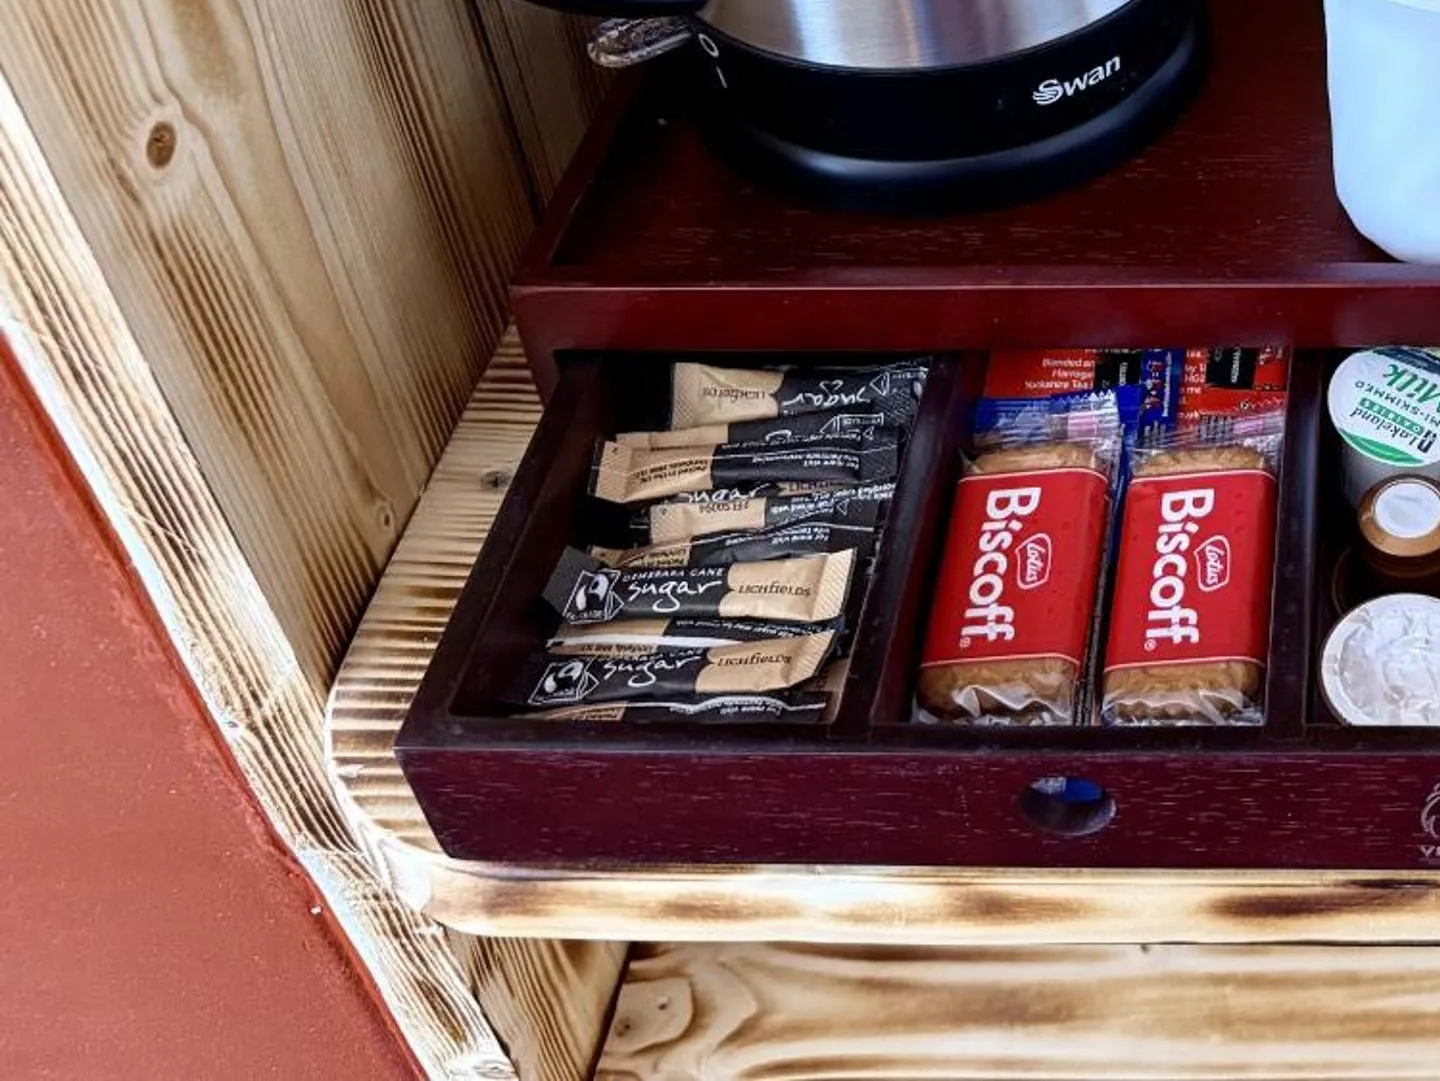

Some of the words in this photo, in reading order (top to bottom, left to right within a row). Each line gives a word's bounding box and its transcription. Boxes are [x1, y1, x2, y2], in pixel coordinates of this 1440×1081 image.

[1032, 56, 1121, 105] Swan
[782, 380, 871, 407] sugar
[1349, 407, 1417, 446] Lakeland
[961, 486, 1042, 642] Biscoff
[1147, 488, 1215, 645] Biscoff
[1204, 540, 1224, 587] Lotus
[628, 580, 723, 612] sugar
[603, 655, 702, 687] sugar
